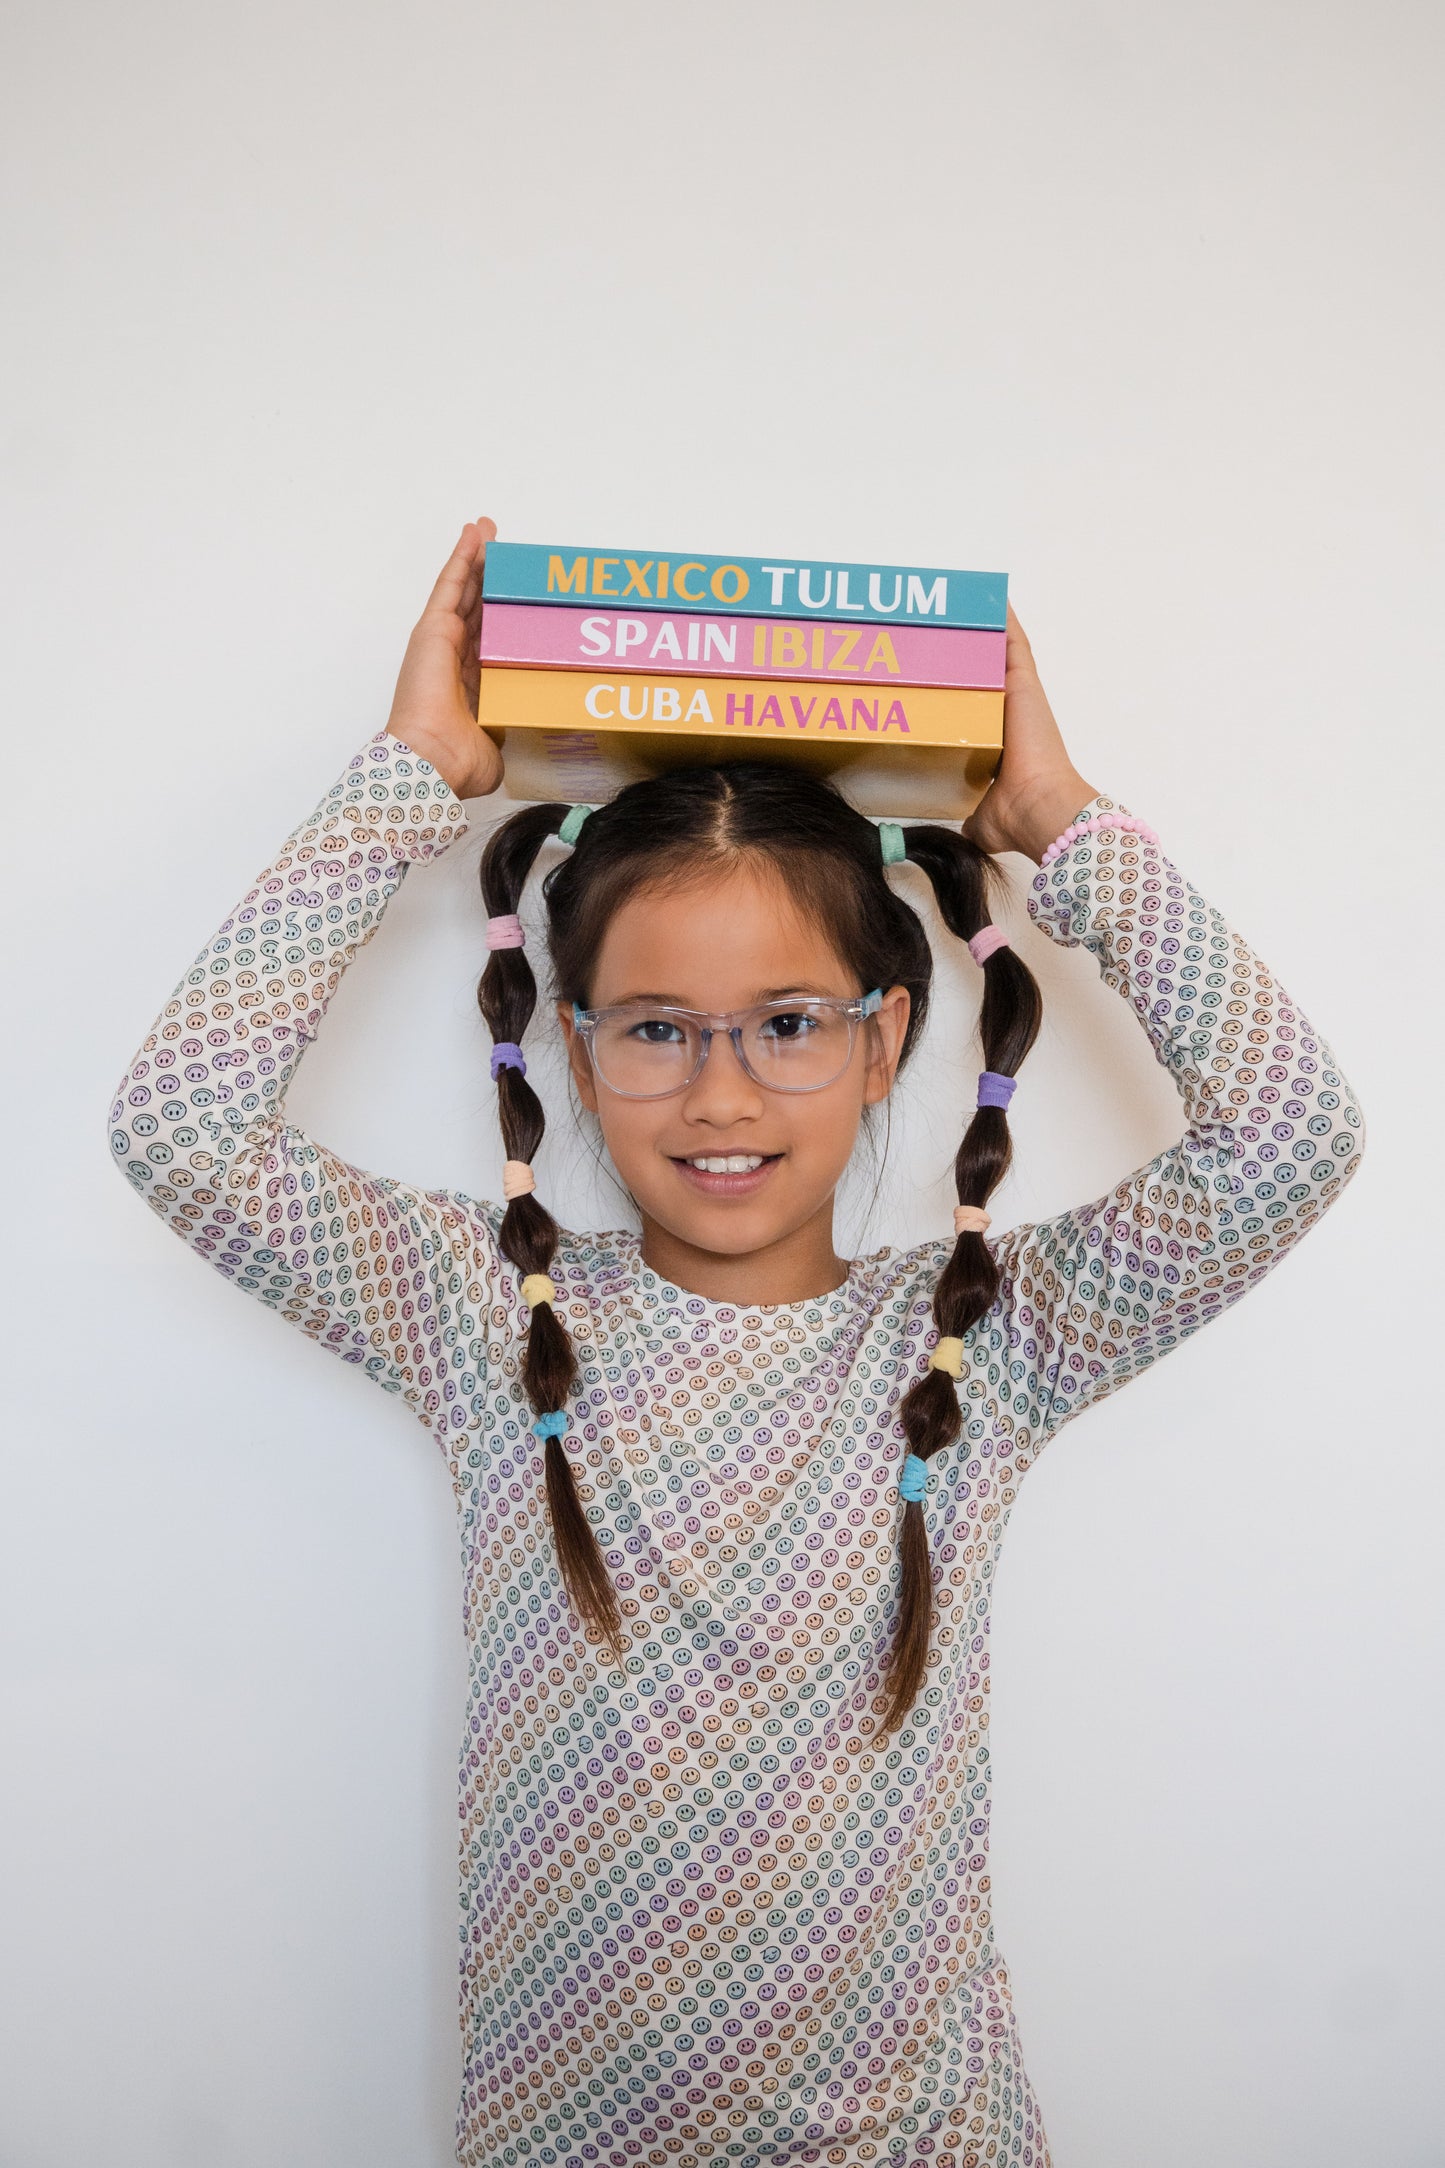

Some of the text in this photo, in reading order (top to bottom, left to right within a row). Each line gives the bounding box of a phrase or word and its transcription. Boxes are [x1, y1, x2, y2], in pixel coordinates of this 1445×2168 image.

[547, 555, 948, 616] MEXICO TULUM
[579, 616, 901, 673] SPAIN IBIZA
[584, 684, 911, 733] CUBA HAVANA
